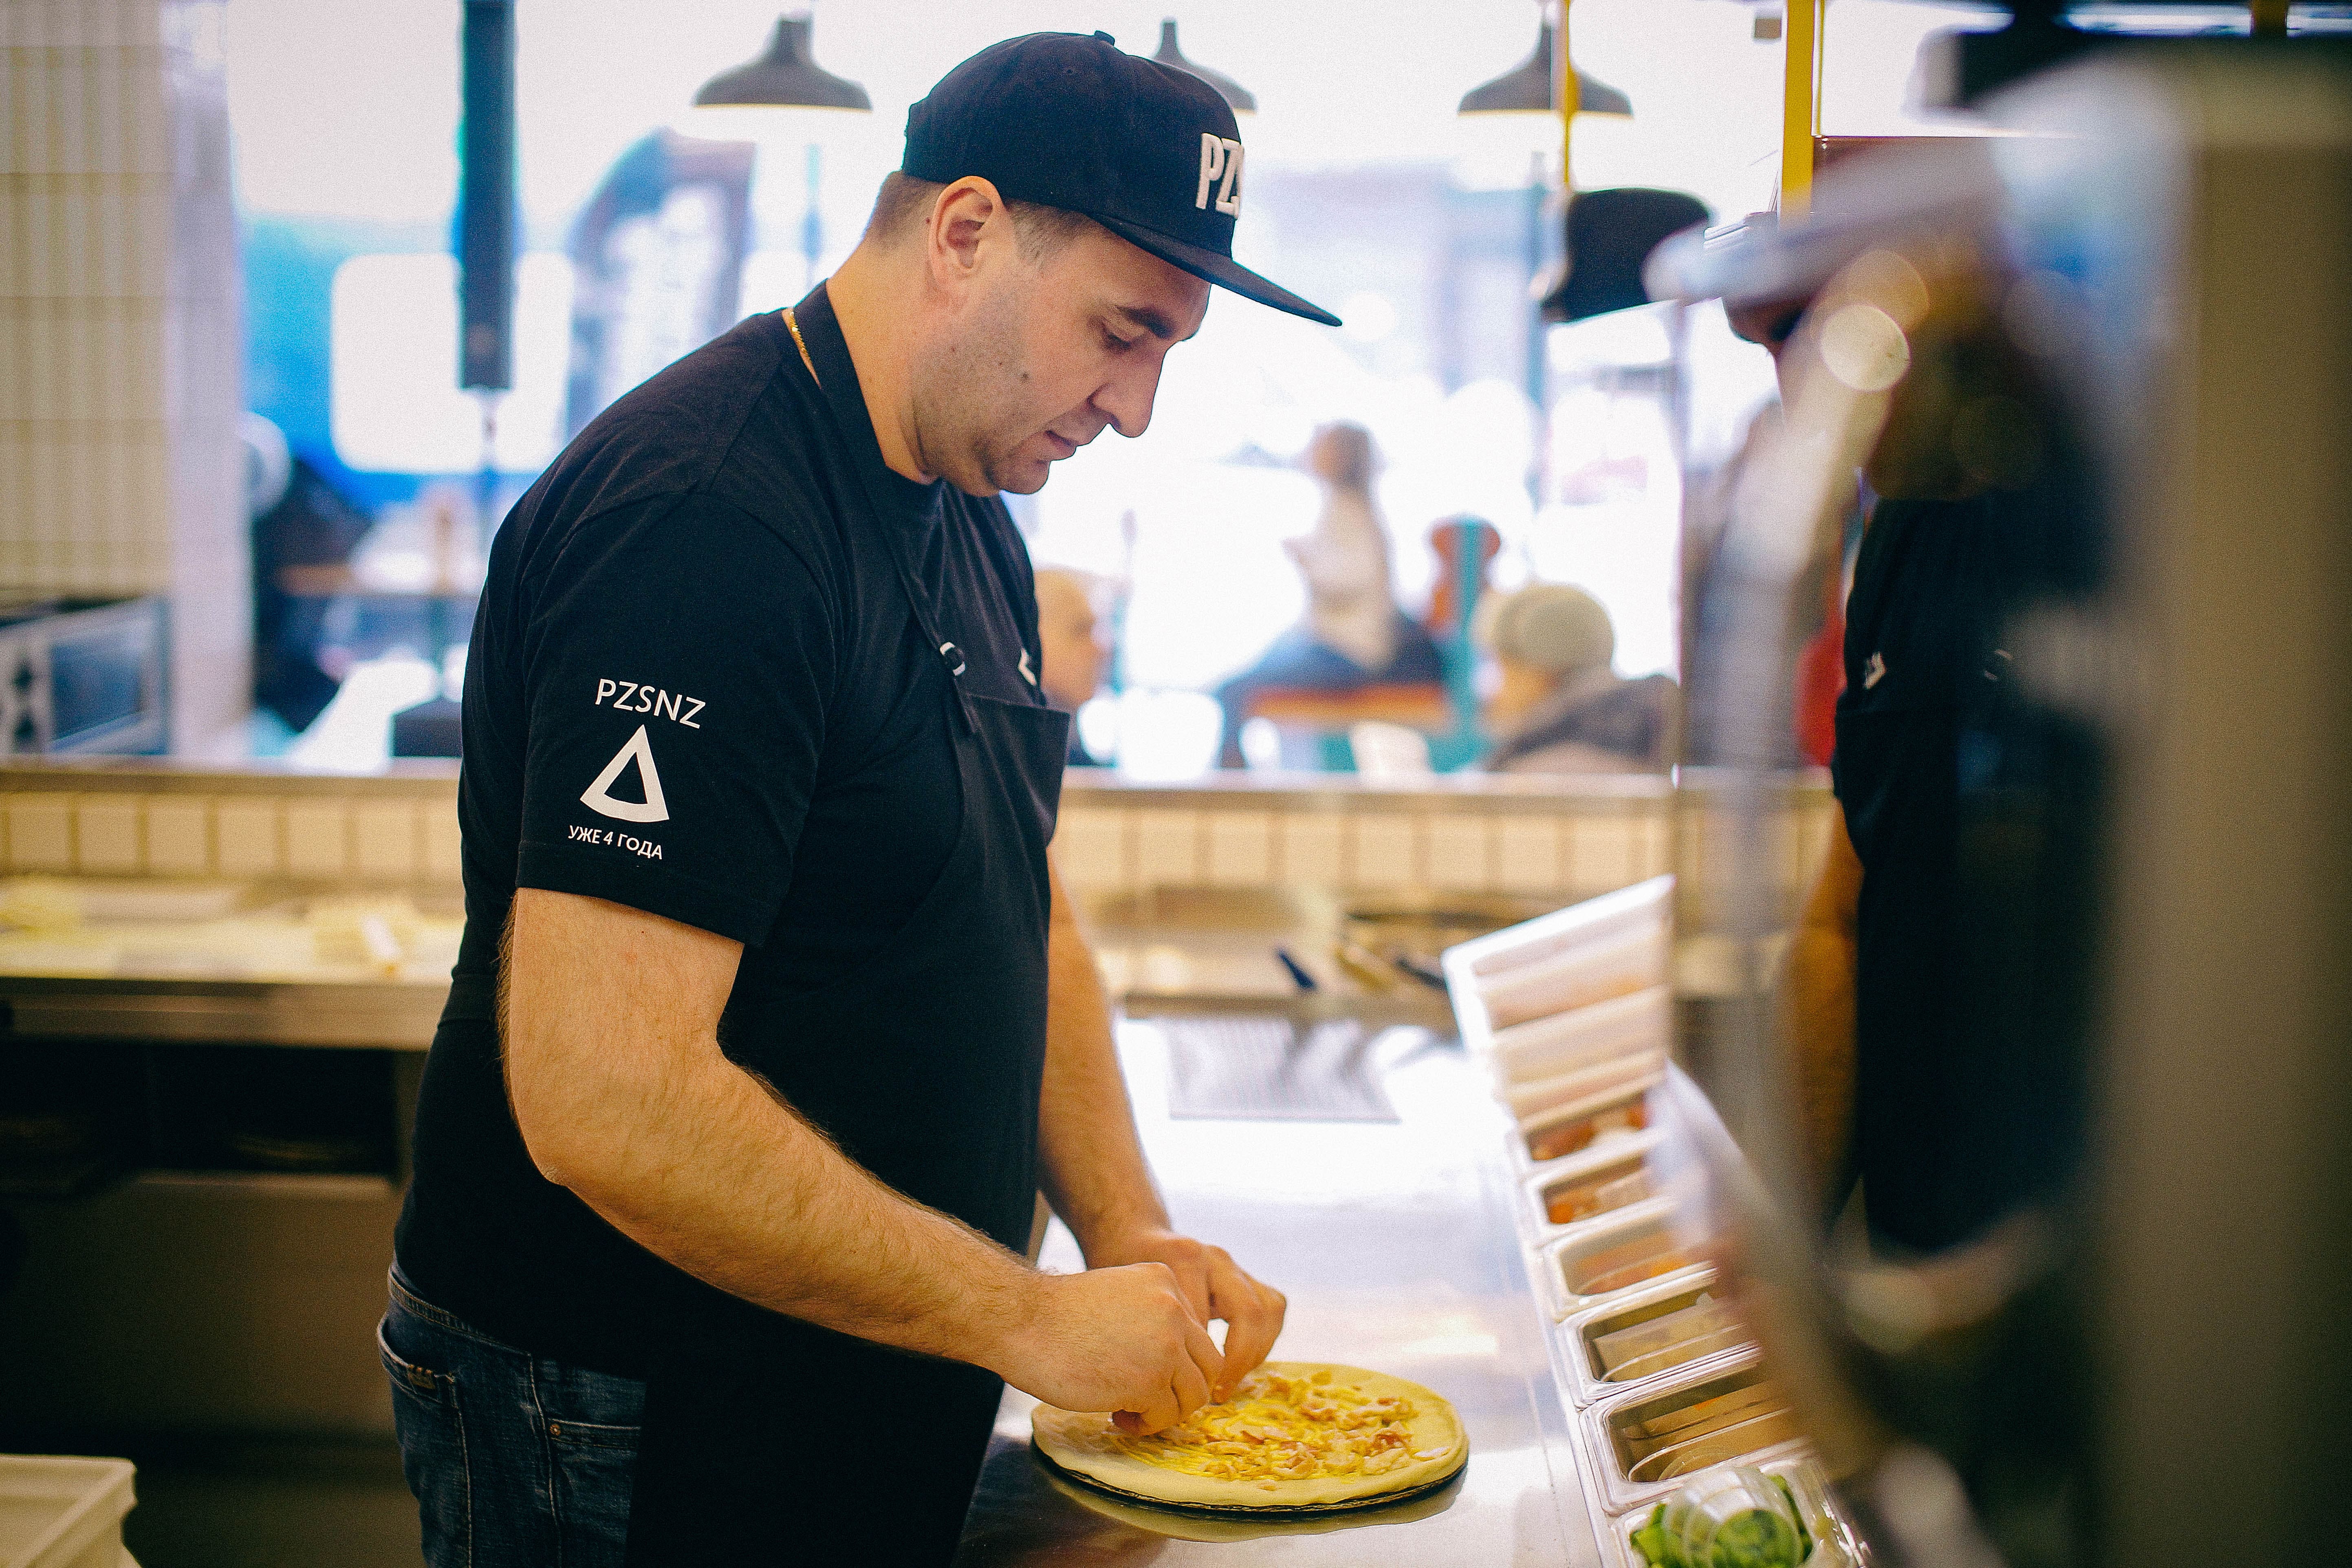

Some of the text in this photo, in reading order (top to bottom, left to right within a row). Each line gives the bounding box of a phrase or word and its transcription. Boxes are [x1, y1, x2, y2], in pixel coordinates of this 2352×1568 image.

[595, 678, 706, 729] PZSNZ
[568, 825, 663, 860] УЖЕ 4 ГОДА
